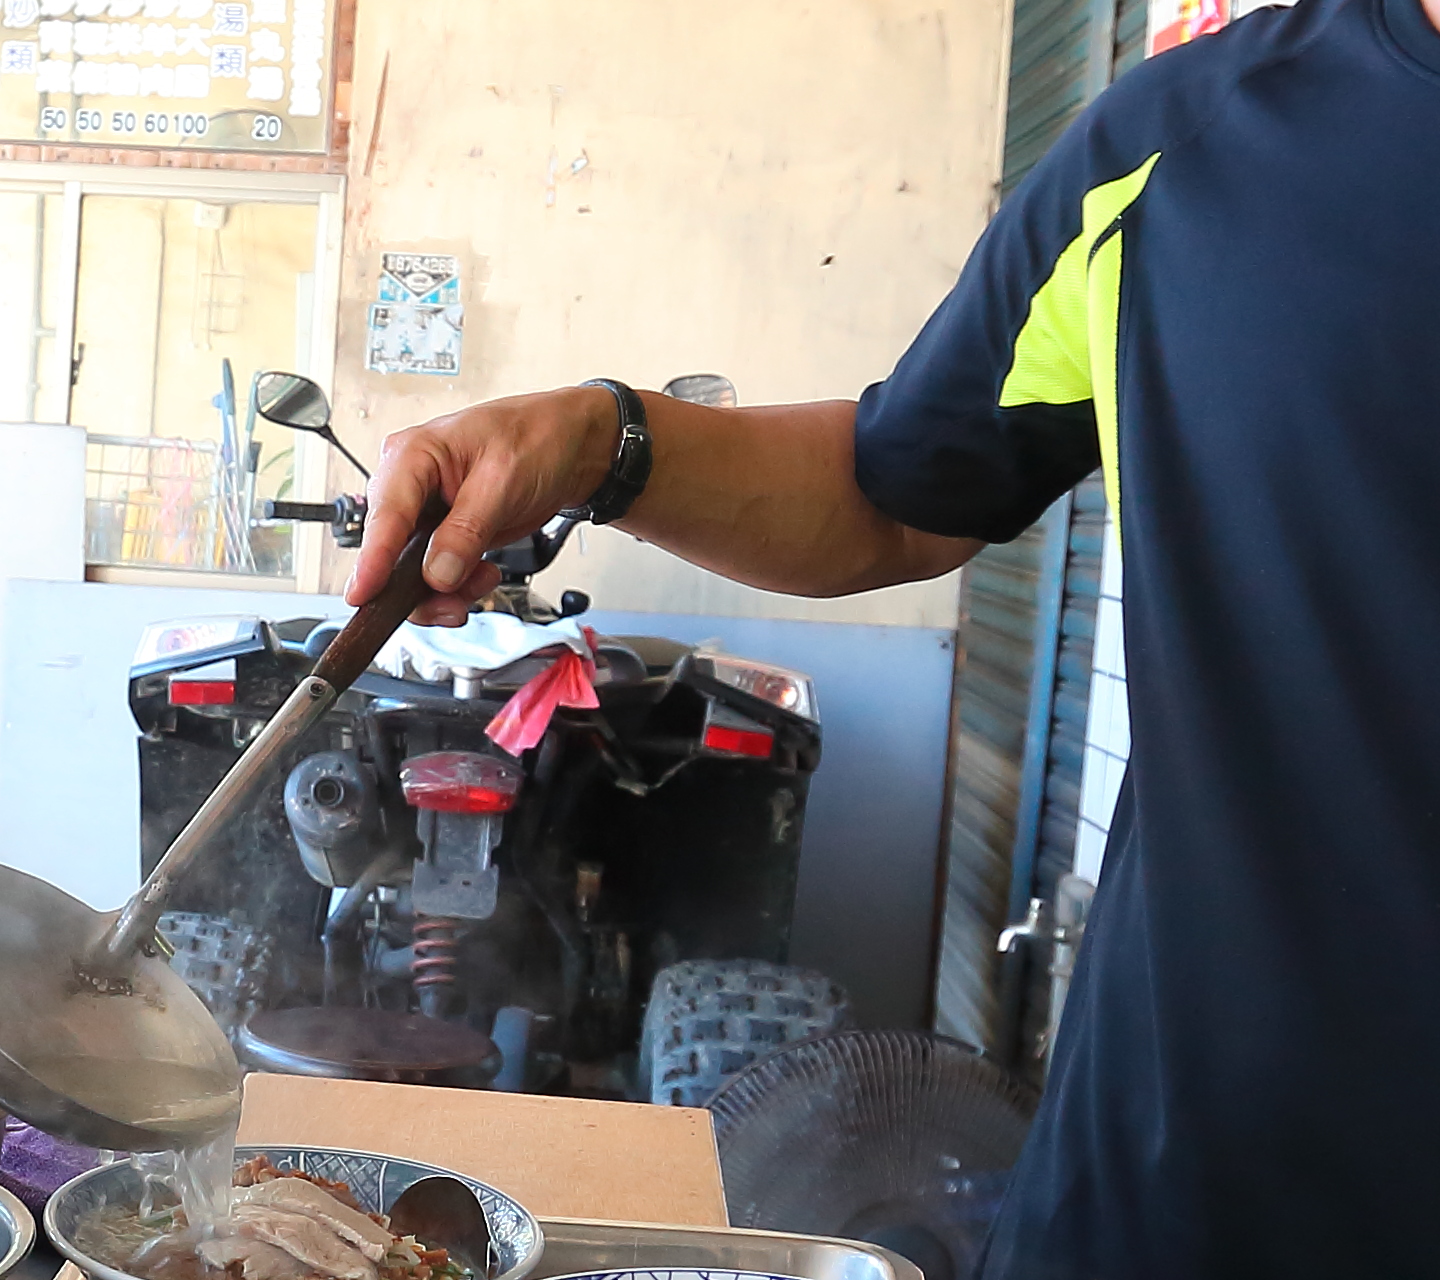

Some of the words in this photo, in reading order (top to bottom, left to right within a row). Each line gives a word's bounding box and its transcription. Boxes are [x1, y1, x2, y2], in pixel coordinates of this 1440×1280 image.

[213, 5, 245, 76] 湯類
[43, 110, 66, 129] 50
[77, 111, 102, 131] 50
[111, 112, 136, 132] 50
[144, 113, 168, 133] 60
[174, 114, 207, 134] 100
[255, 118, 279, 138] 20
